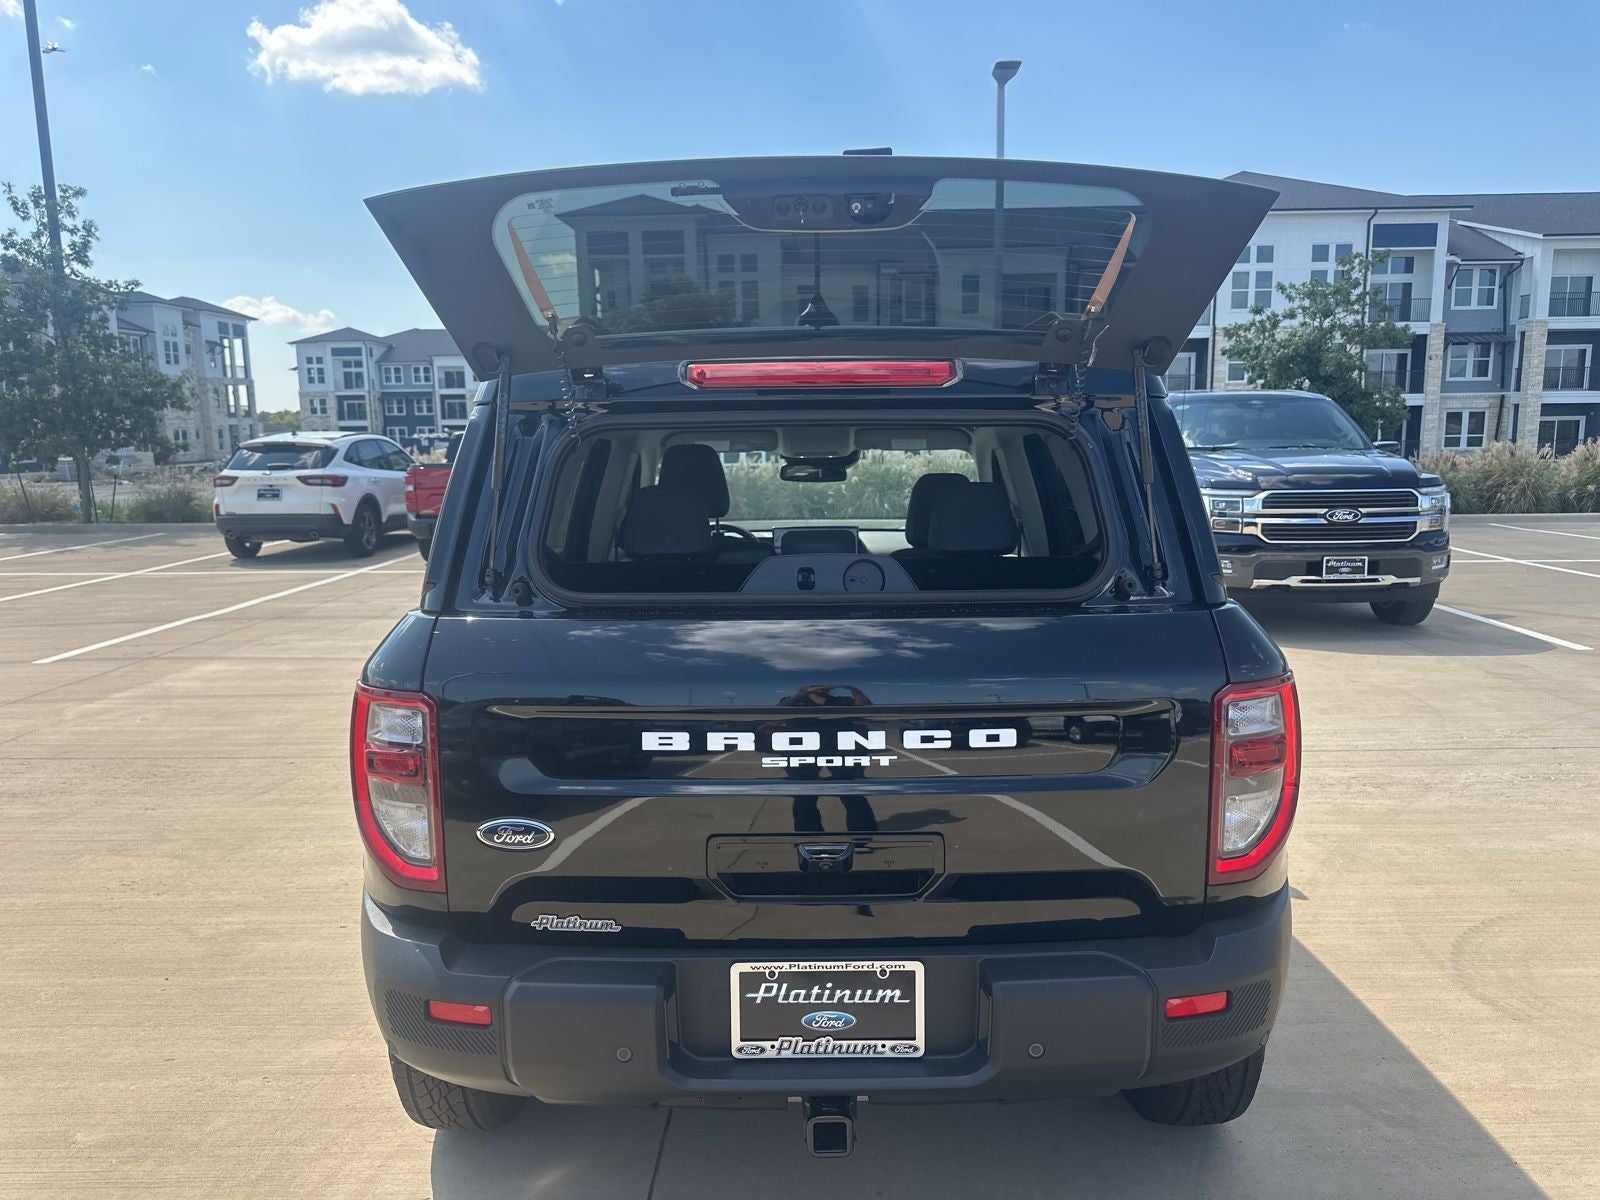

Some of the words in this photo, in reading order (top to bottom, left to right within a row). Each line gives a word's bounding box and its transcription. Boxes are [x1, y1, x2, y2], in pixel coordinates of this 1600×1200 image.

[1332, 511, 1355, 520] Ford
[641, 728, 1017, 751] BRONCO
[761, 755, 898, 768] SPORT
[493, 825, 535, 844] Ford
[531, 914, 621, 932] Platinum
[750, 963, 906, 971] www.PlatinumFord.com
[745, 982, 911, 1004] Platinum
[811, 1013, 845, 1028] Ford
[774, 1037, 886, 1056] Platinum
